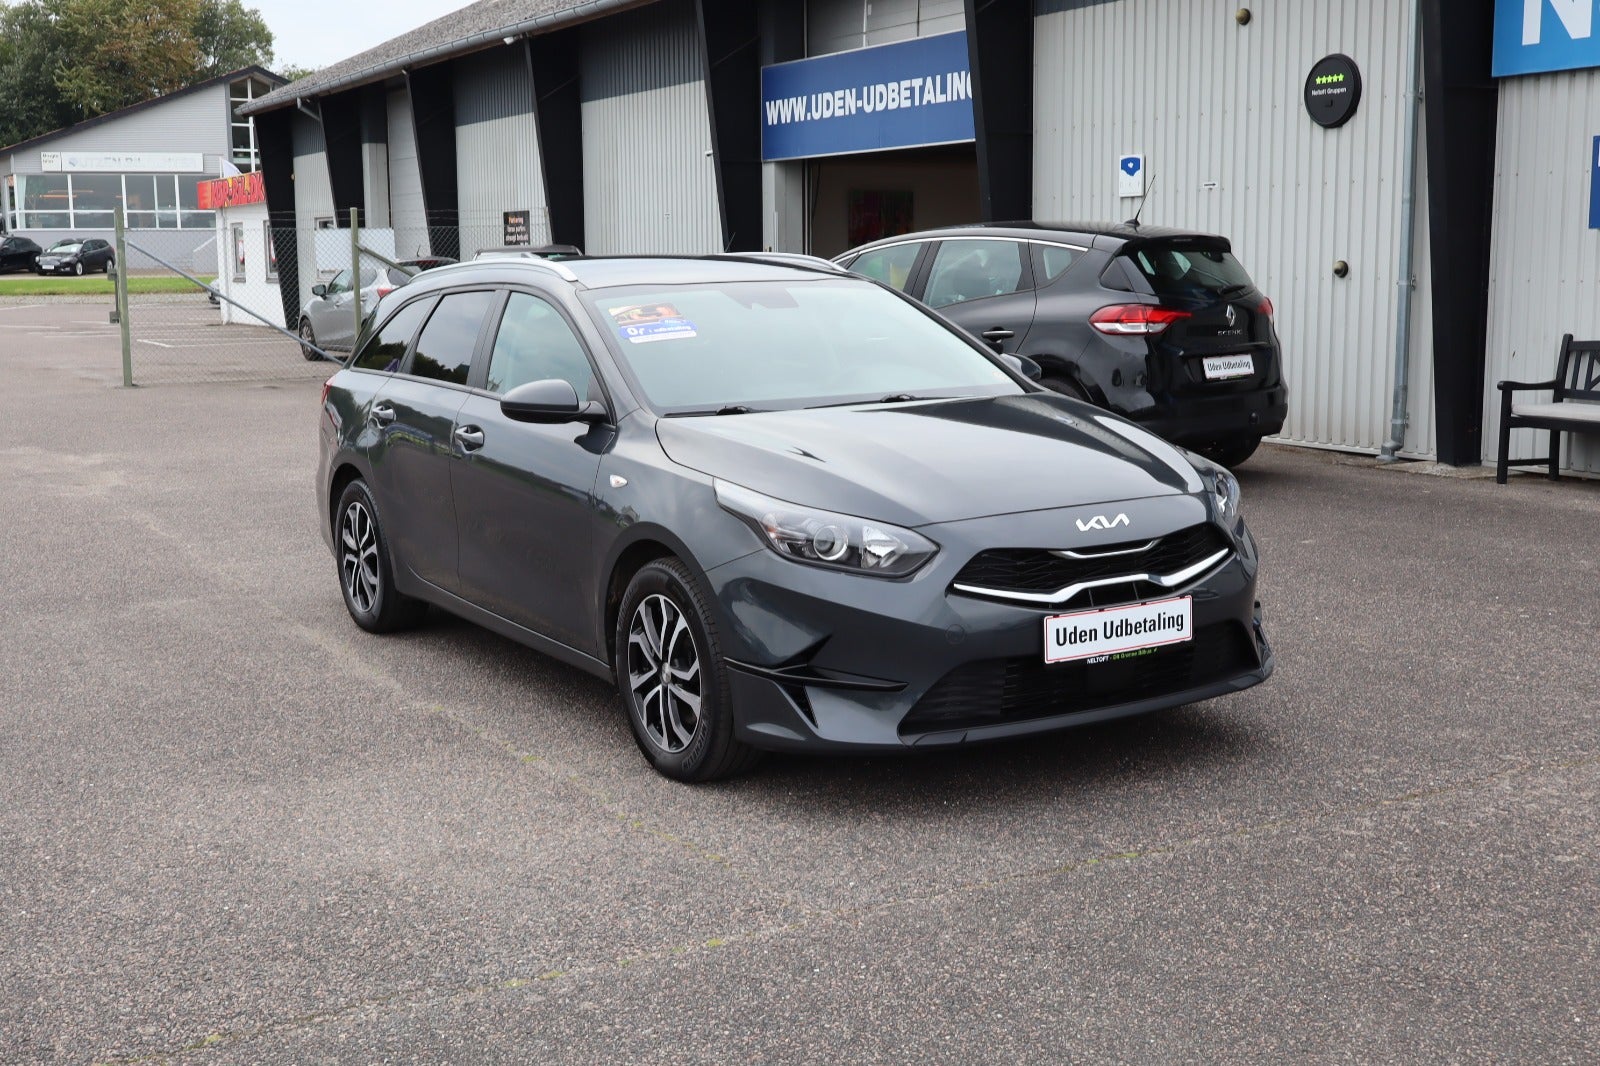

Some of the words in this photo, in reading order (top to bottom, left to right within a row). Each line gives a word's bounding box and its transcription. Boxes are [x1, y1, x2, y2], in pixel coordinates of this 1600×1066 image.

[1327, 87, 1347, 95] Gruppen
[1075, 513, 1130, 532] KIA
[1056, 625, 1098, 647] Uden
[1103, 611, 1184, 640] Udbetaling
[1086, 655, 1109, 665] NELTOFT
